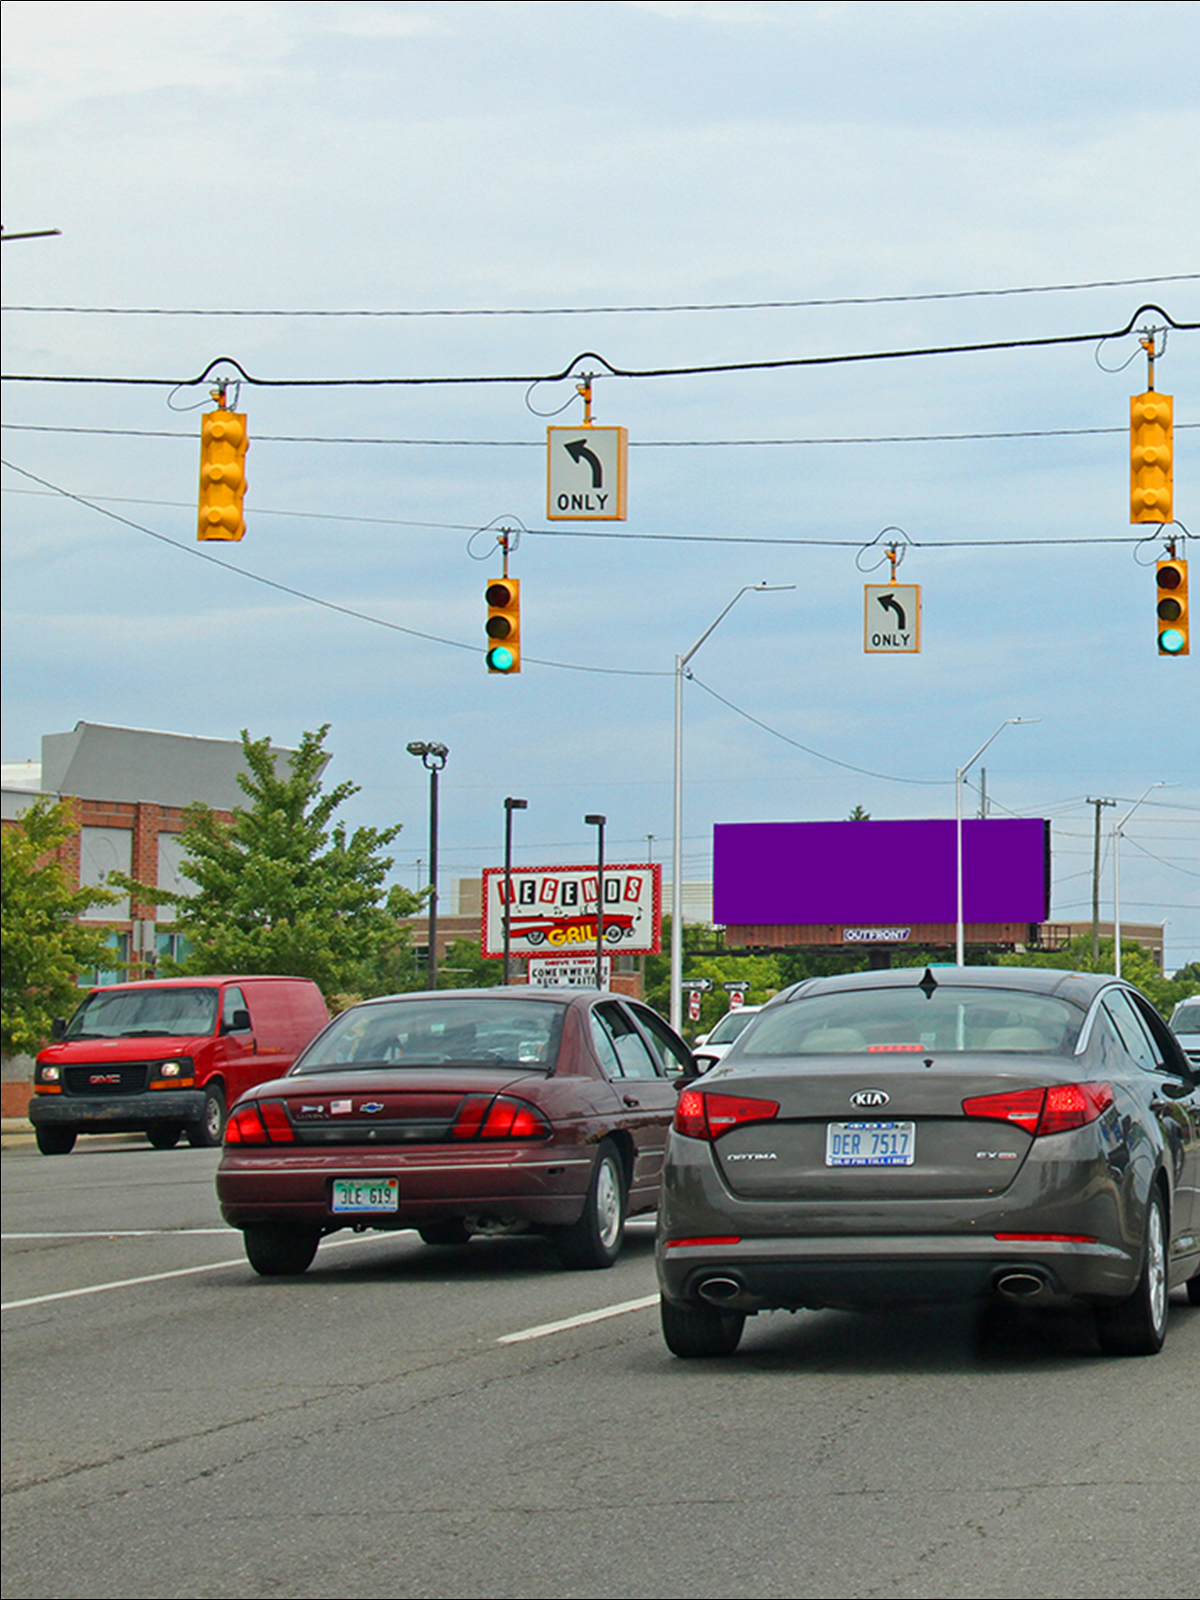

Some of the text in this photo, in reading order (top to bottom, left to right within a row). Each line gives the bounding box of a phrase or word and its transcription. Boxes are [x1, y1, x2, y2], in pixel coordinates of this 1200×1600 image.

[557, 493, 609, 511] ONLY
[872, 633, 910, 647] ONLY
[846, 929, 909, 940] OUTFRONT
[532, 968, 557, 977] COME
[584, 966, 608, 975] HAE
[568, 976, 607, 985] WAITIG
[89, 1074, 121, 1085] GMC
[856, 1093, 882, 1105] KIA
[832, 1133, 909, 1155] DER 7517
[726, 1153, 778, 1161] OPTIMA
